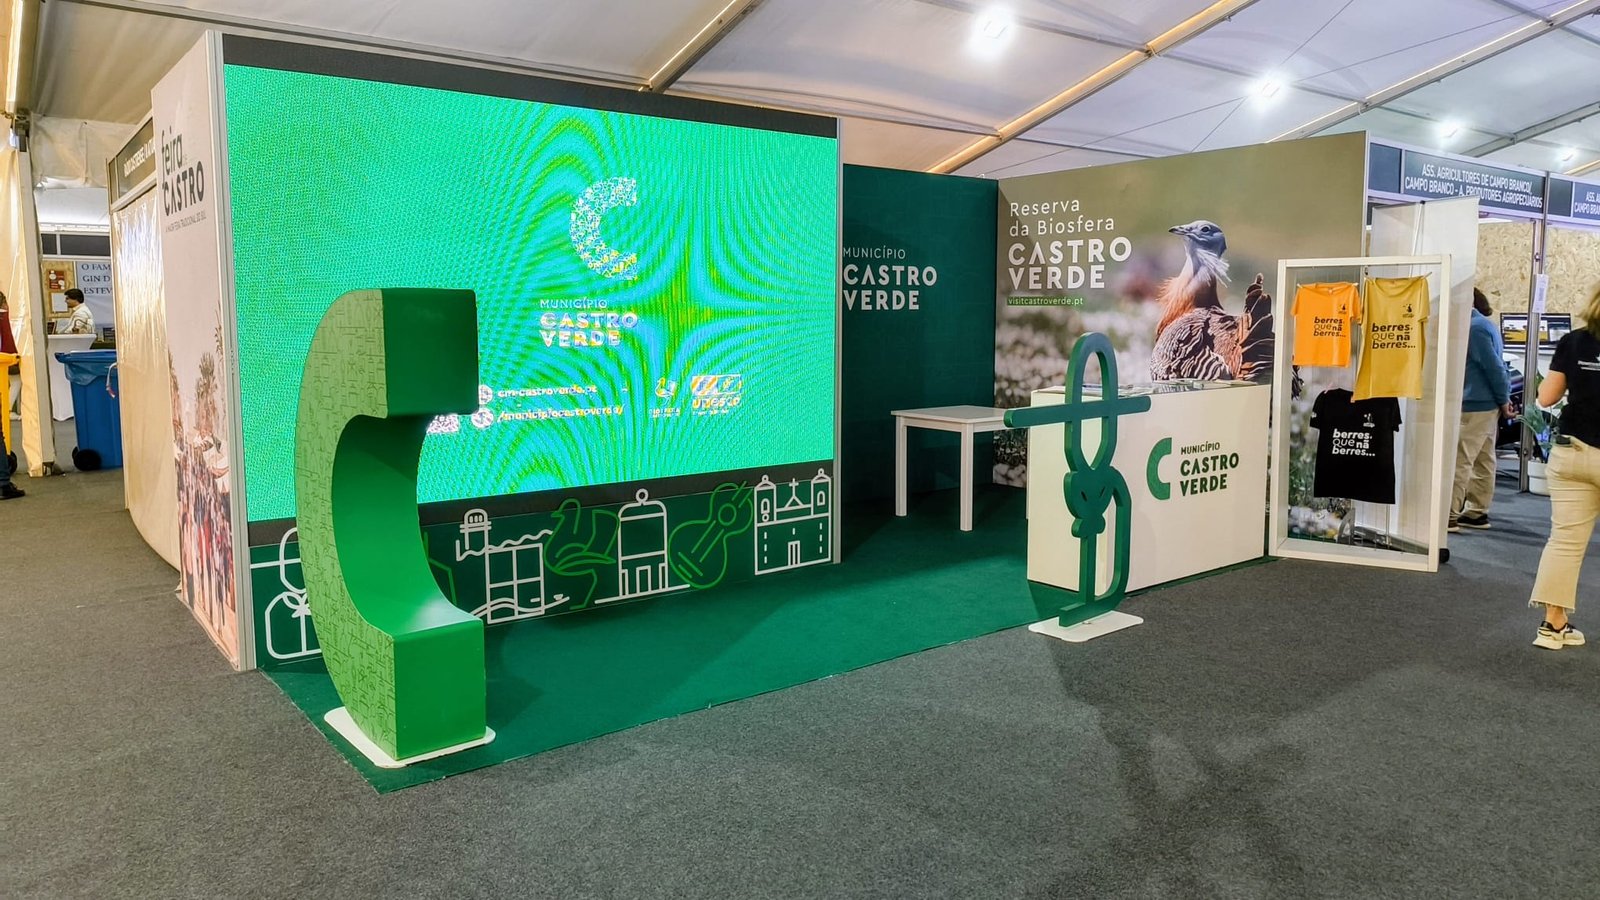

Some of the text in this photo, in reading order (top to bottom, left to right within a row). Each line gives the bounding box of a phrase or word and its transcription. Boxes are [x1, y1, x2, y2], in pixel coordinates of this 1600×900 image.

[162, 125, 182, 188] feira
[1405, 177, 1428, 191] CAMPO
[1429, 180, 1455, 195] BRANCO
[1422, 164, 1435, 178] ASS.
[1437, 166, 1480, 185] AGRICULTORES
[1481, 174, 1488, 186] DE
[1489, 176, 1509, 189] CAMPO
[164, 161, 204, 216] CASTRO
[1010, 199, 1080, 217] Reserva
[1010, 215, 1115, 237] da Biosfera
[843, 245, 906, 259] MUNICÍPIO
[1008, 236, 1132, 266] CASTRO
[843, 265, 938, 286] CASTRO
[1008, 265, 1105, 290] VERDE
[843, 290, 920, 310] VERDE
[1008, 297, 1084, 306] visitcastroverde.pt
[540, 312, 638, 329] CASTRO
[540, 330, 621, 348] VERDE
[1396, 332, 1410, 341] nã
[1181, 441, 1220, 455] MUNICÍPIO
[1356, 440, 1369, 449] nã
[1180, 453, 1239, 476] CASTRO
[1180, 474, 1227, 496] VERDE
